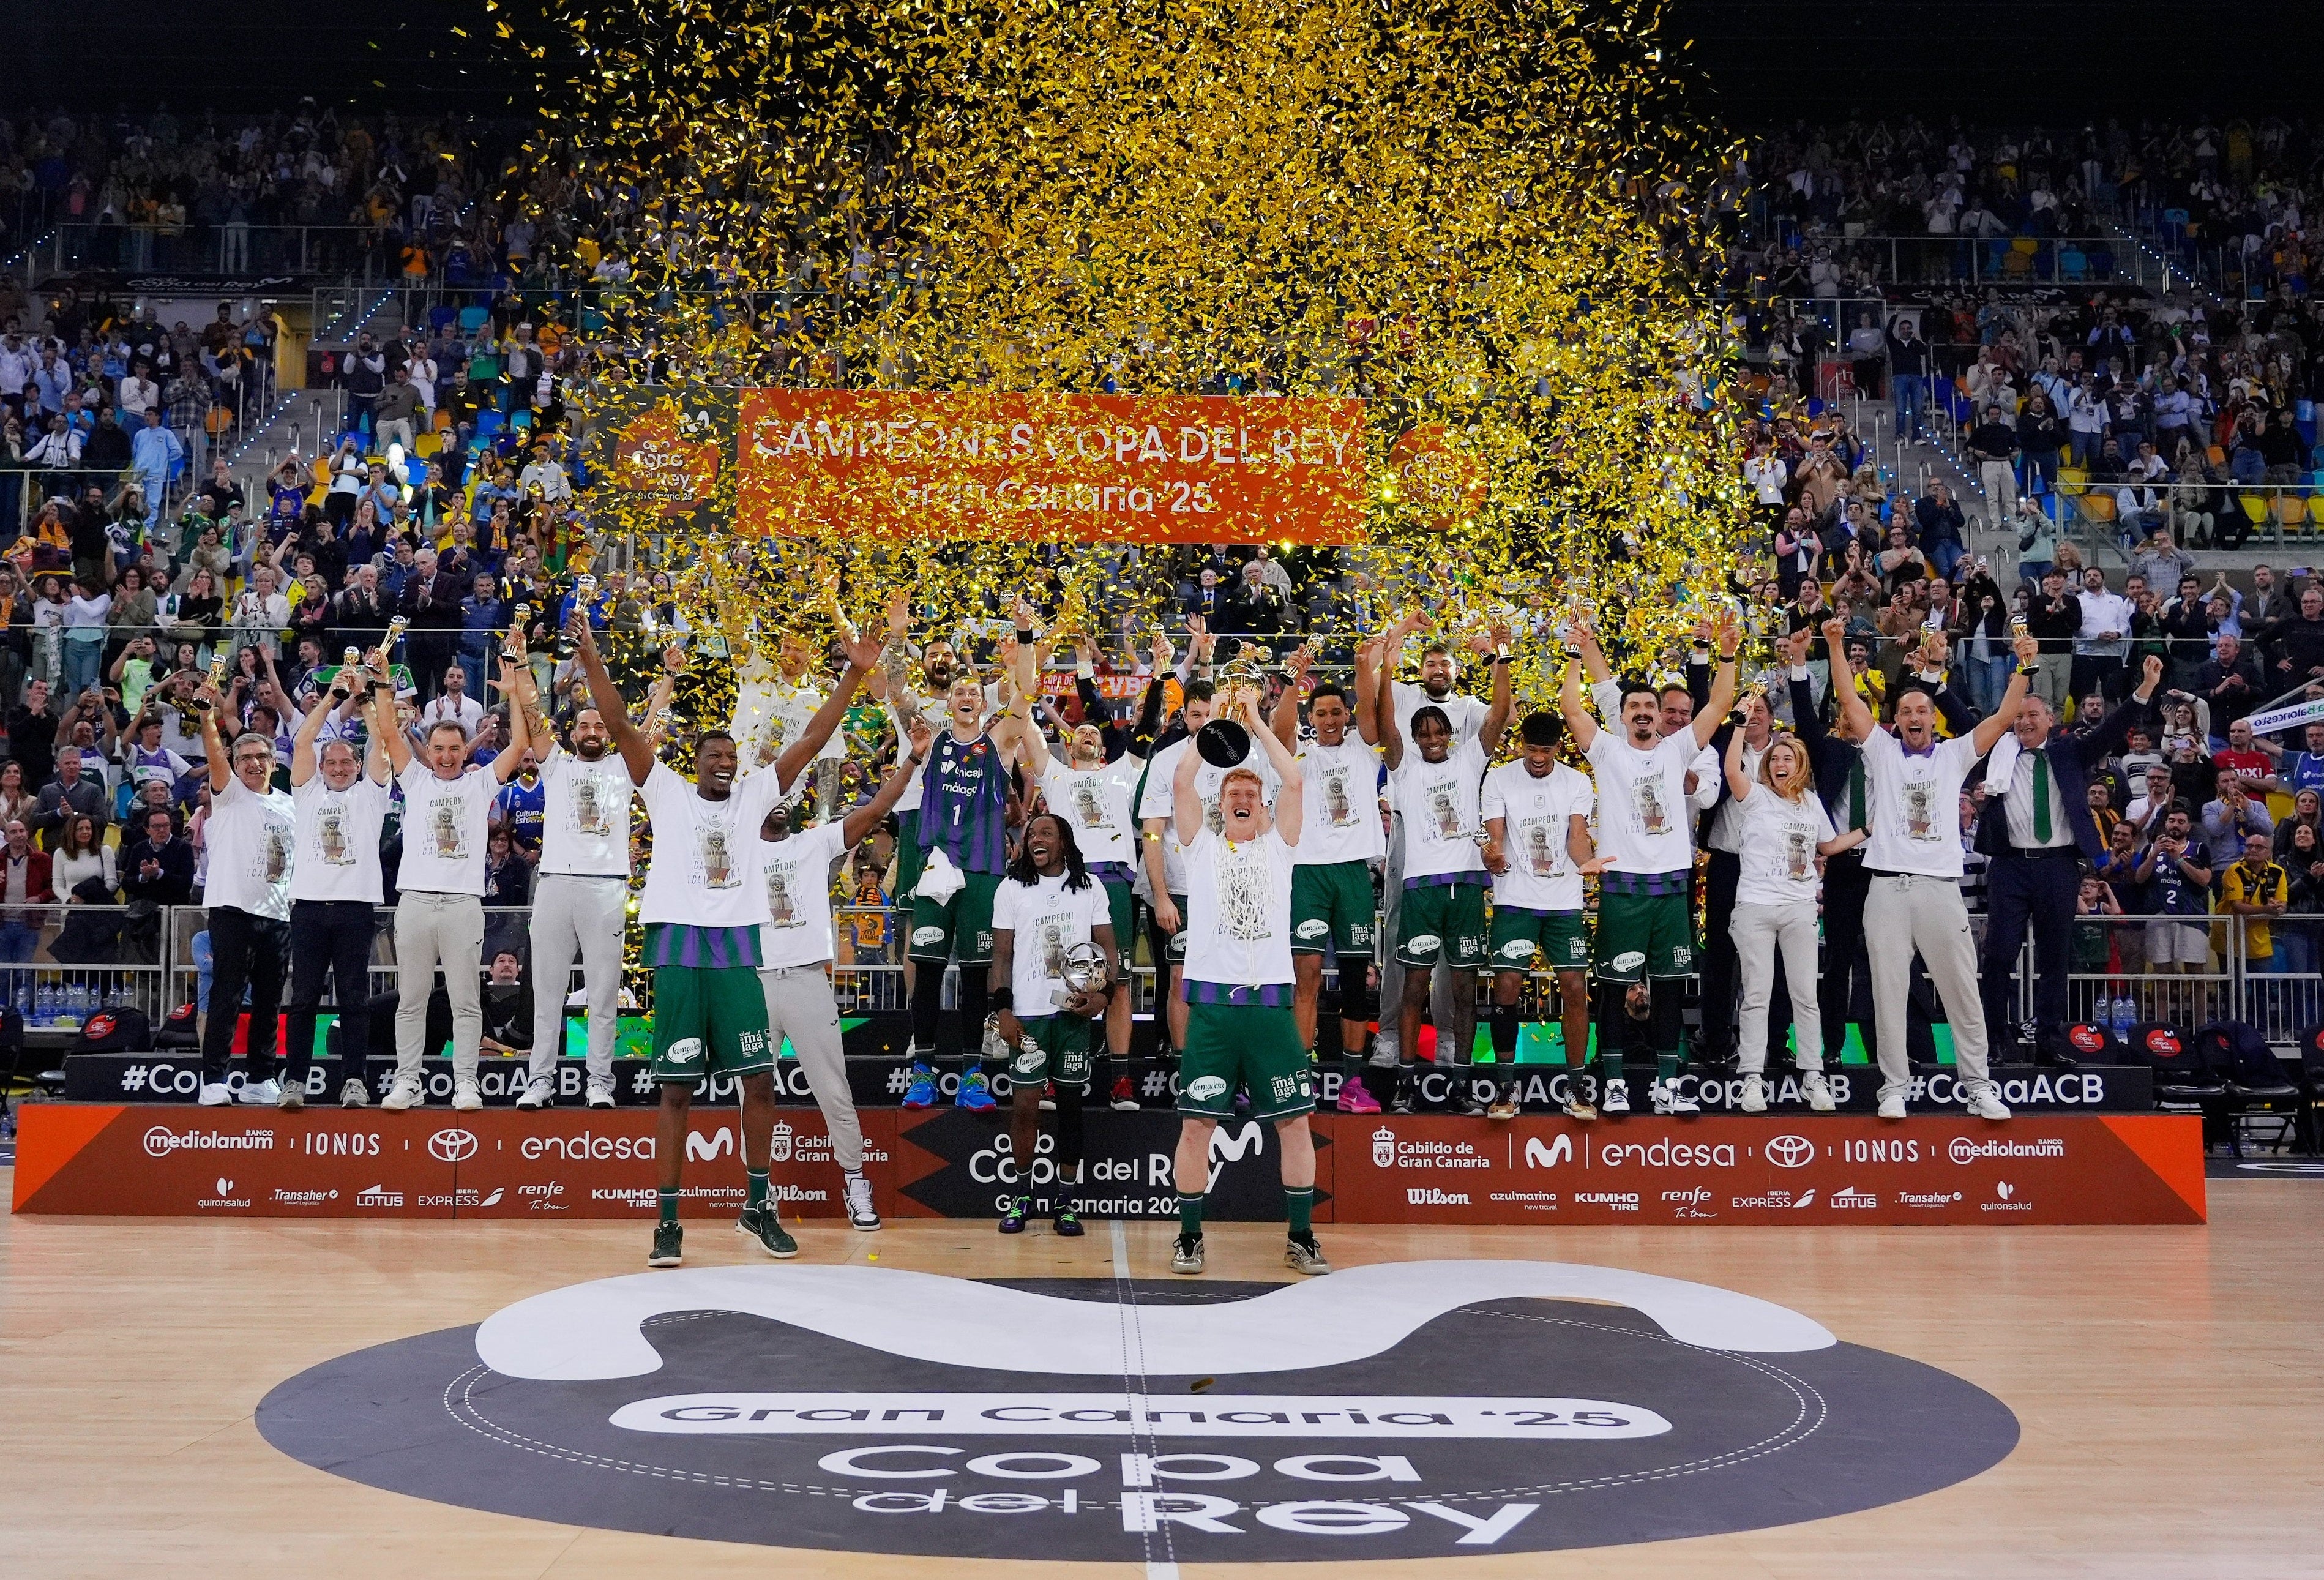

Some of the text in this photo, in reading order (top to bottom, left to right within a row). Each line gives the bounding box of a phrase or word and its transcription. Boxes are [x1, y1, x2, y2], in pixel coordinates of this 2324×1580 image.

[1179, 426, 1261, 463] DEL
[1274, 429, 1351, 465] REY
[953, 804, 962, 826] 1
[1519, 813, 1558, 828] ¡CAMPEÓN!
[2160, 877, 2182, 886] málag
[2166, 889, 2176, 904] 2
[1033, 911, 1074, 929] ¡CAMPEÓN!
[1299, 923, 1328, 935] famadesa
[741, 1041, 764, 1053] laga
[1063, 1060, 1083, 1071] laga
[1192, 1079, 1226, 1093] famadesa
[1276, 1074, 1295, 1087] má
[1273, 1085, 1298, 1098] laga
[149, 1129, 274, 1150] mediolanum
[305, 1132, 381, 1156] IONOS
[521, 1130, 656, 1160] endesa
[794, 1135, 832, 1148] Cabil
[993, 1129, 1055, 1154] ab
[1397, 1141, 1474, 1155] Cabildo de
[1601, 1137, 1735, 1167] endesa
[1844, 1139, 1919, 1163] IONOS
[1953, 1140, 2064, 1157] mediolanum
[794, 1149, 830, 1162] Gran
[1397, 1155, 1490, 1169] Gran Canaria
[1093, 1157, 1138, 1181] del
[1149, 1153, 1225, 1193] Ry
[518, 1180, 564, 1199] renfe
[592, 1188, 657, 1200] KUMHO
[678, 1186, 747, 1197] zulmarino
[1406, 1188, 1471, 1205] Wilson
[1489, 1190, 1557, 1201] azulmarino
[1661, 1185, 1711, 1205] renfe
[356, 1195, 404, 1207] LOTUS
[418, 1195, 480, 1207] EXPRESS
[626, 1199, 657, 1208] TIRE
[1055, 1194, 1143, 1215] anaria
[1148, 1196, 1181, 1215] 202
[1575, 1192, 1640, 1204] KUMHO
[1732, 1197, 1792, 1208] EXPRESS
[1831, 1197, 1877, 1208] LOTUS
[1608, 1203, 1639, 1211] TIRE
[659, 1405, 944, 1423] Gran
[979, 1406, 1455, 1426] Canaria
[818, 1444, 1423, 1488] Copa
[851, 1488, 1541, 1545] del Rey
